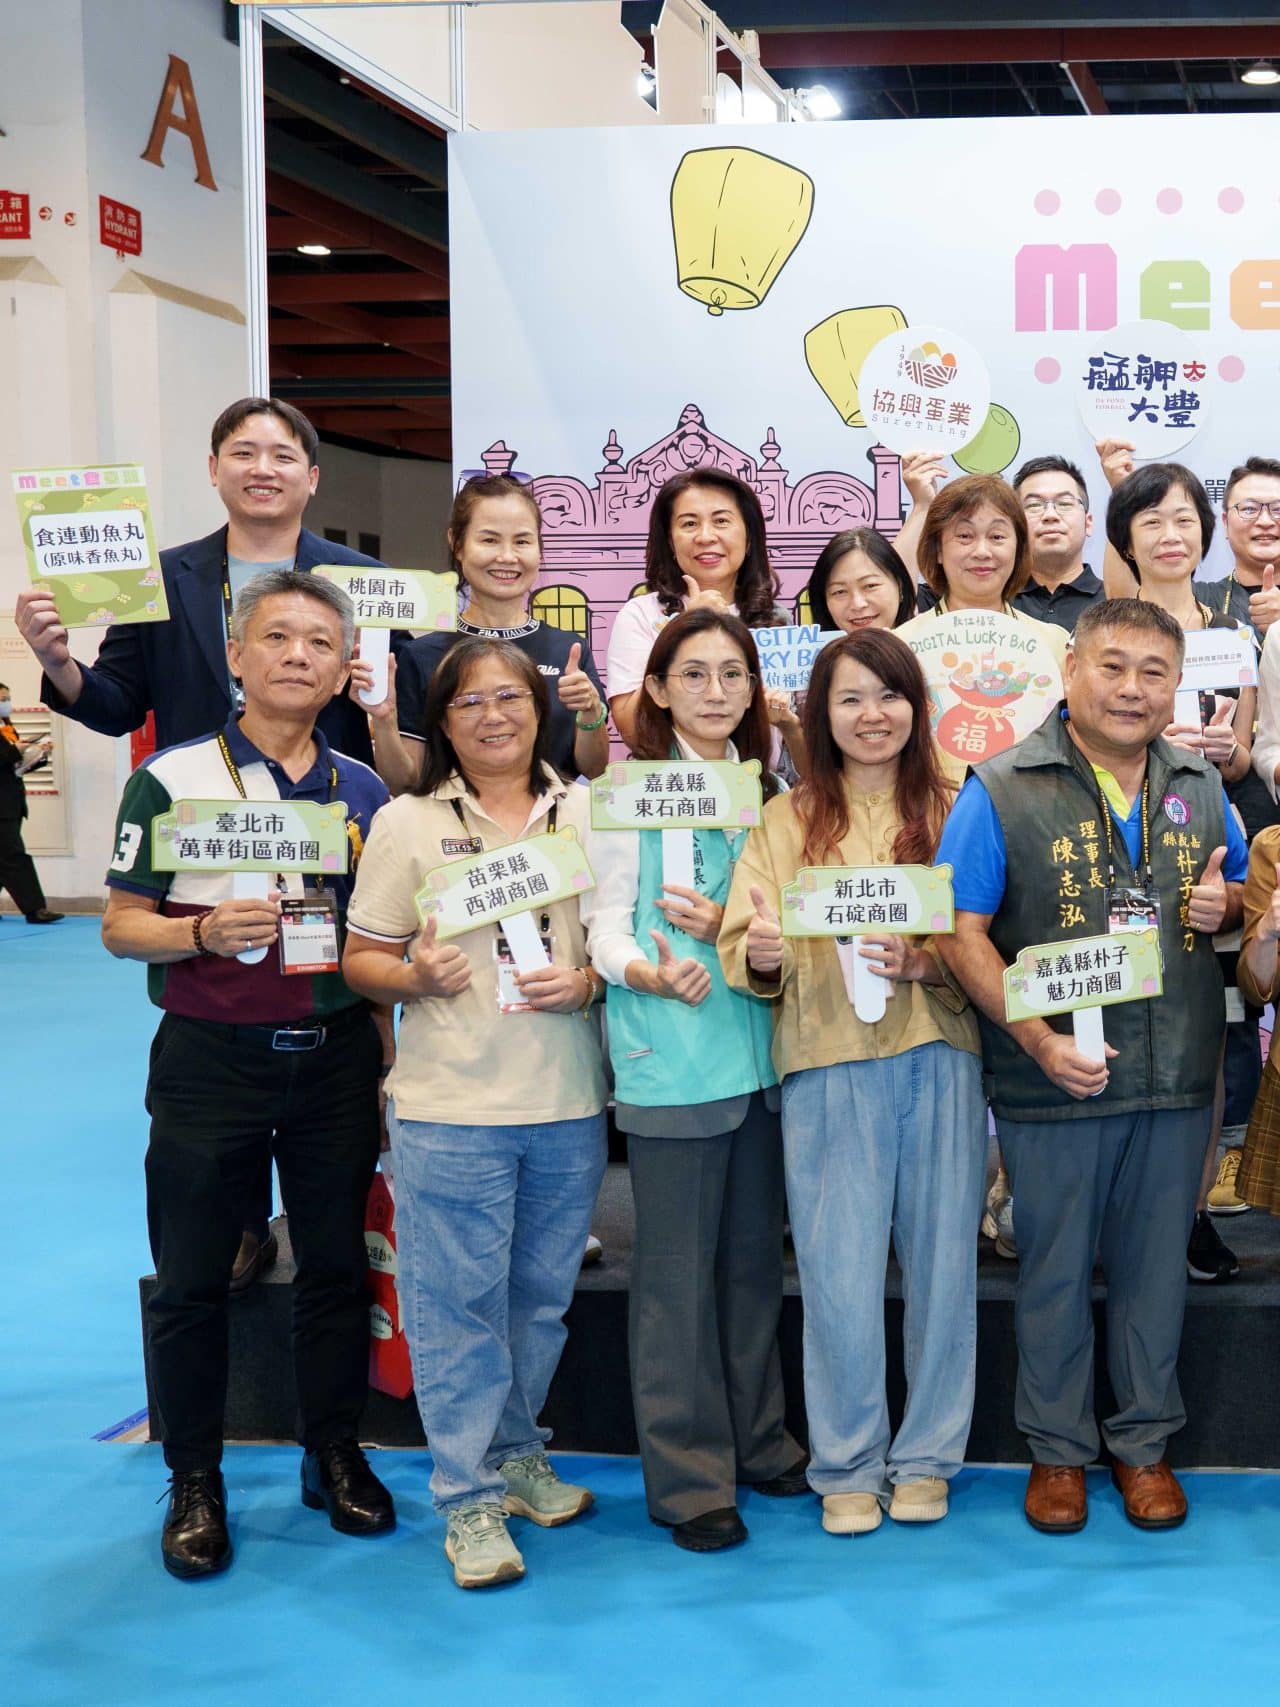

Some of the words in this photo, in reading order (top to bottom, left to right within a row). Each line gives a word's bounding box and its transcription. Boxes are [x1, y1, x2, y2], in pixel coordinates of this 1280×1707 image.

[140, 53, 218, 191] A
[105, 221, 137, 240] HYDRANT
[873, 389, 971, 426] 協興蛋業
[34, 522, 145, 548] 食連動魚丸
[348, 577, 406, 597] 桃園市
[357, 599, 415, 619] 行商圈
[952, 721, 987, 754] 福
[644, 772, 706, 793] 嘉義縣
[635, 797, 717, 818] 東石商圈
[216, 813, 285, 834] 臺北市
[111, 822, 143, 872] 3
[180, 838, 320, 861] 萬華街區商圈
[1079, 820, 1106, 888] 理事長
[464, 852, 531, 889] 苗栗縣
[1052, 836, 1085, 928] 陳志泓
[464, 873, 549, 916] 西湖商圈
[834, 878, 897, 899] 新北市
[824, 903, 908, 924] 石碇商圈
[1035, 945, 1130, 978] 嘉義縣朴子
[1047, 971, 1121, 1002] 魅力商圈
